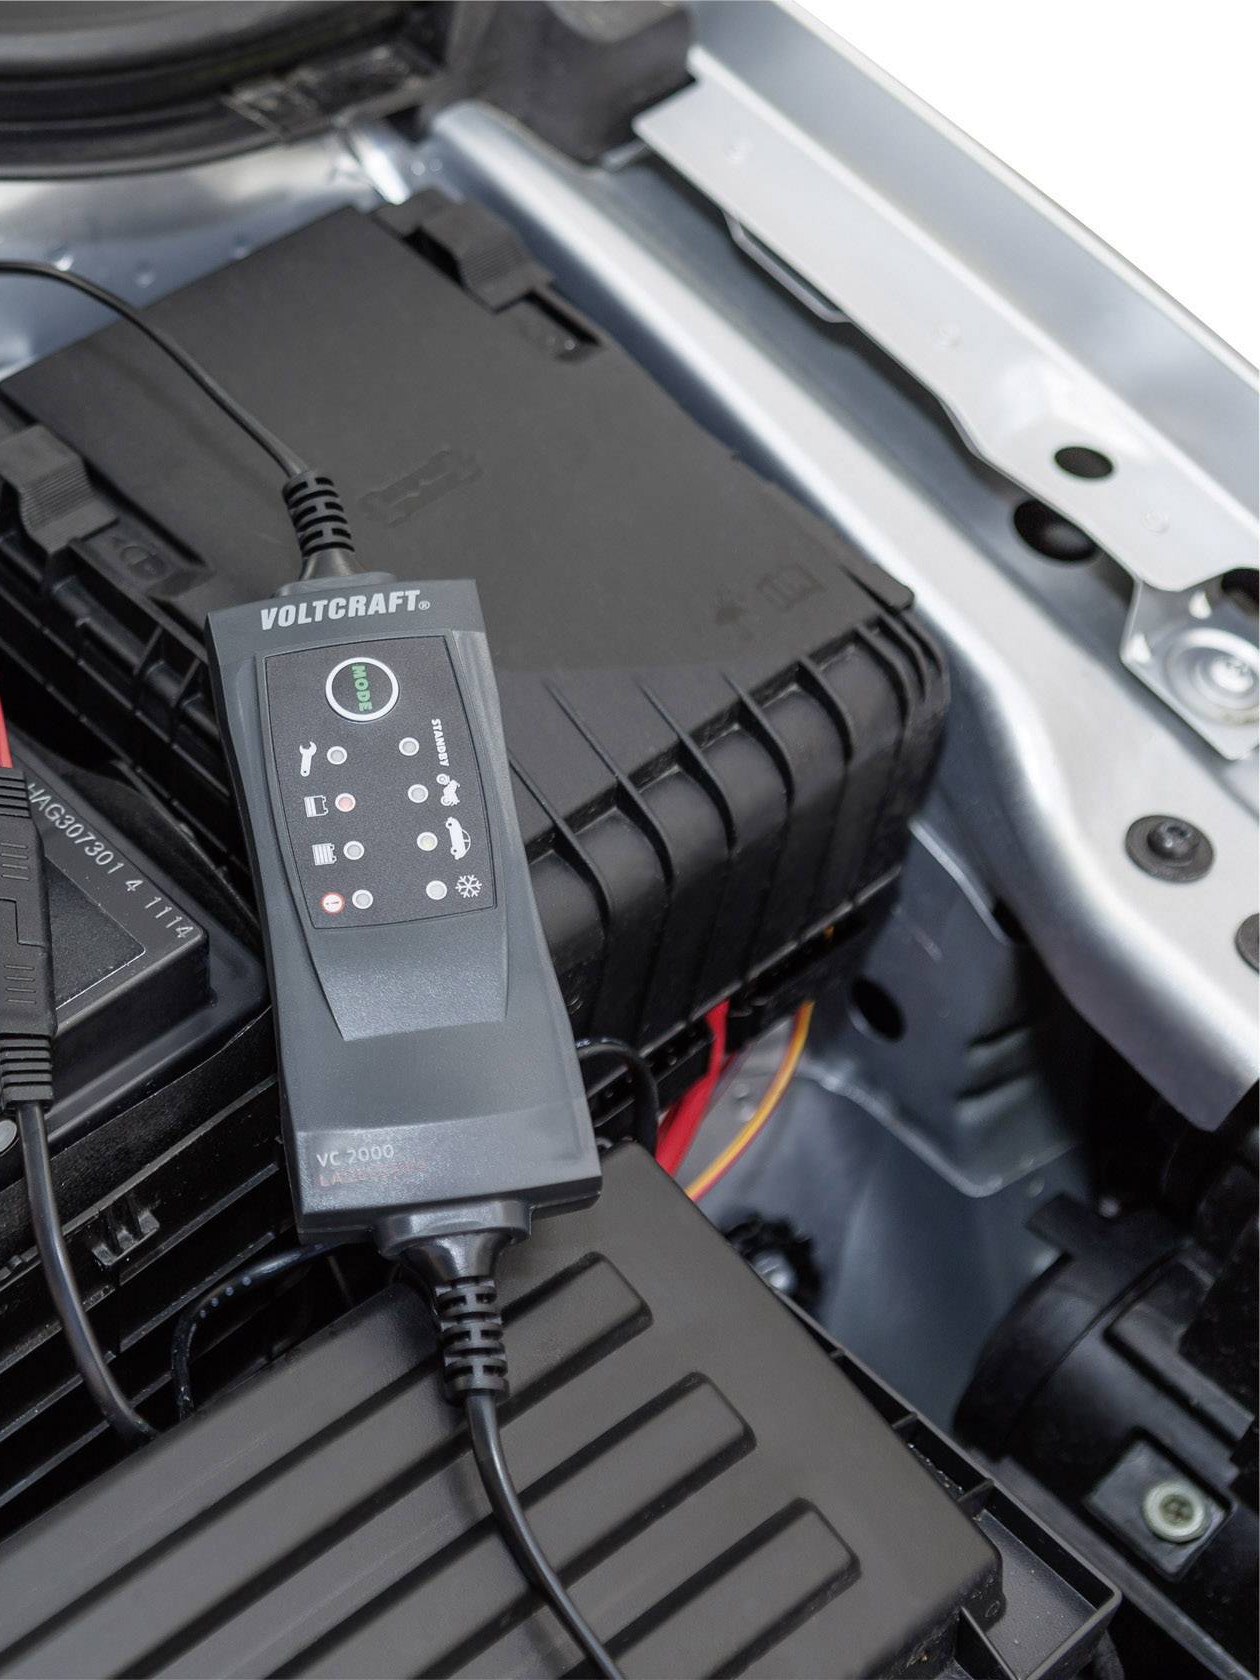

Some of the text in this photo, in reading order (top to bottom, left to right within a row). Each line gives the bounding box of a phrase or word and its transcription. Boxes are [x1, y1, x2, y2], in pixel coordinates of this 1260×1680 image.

[351, 664, 373, 711] MODE
[431, 718, 450, 768] STANDBY
[145, 896, 194, 938] 1114
[316, 1144, 395, 1168] VC 2000
